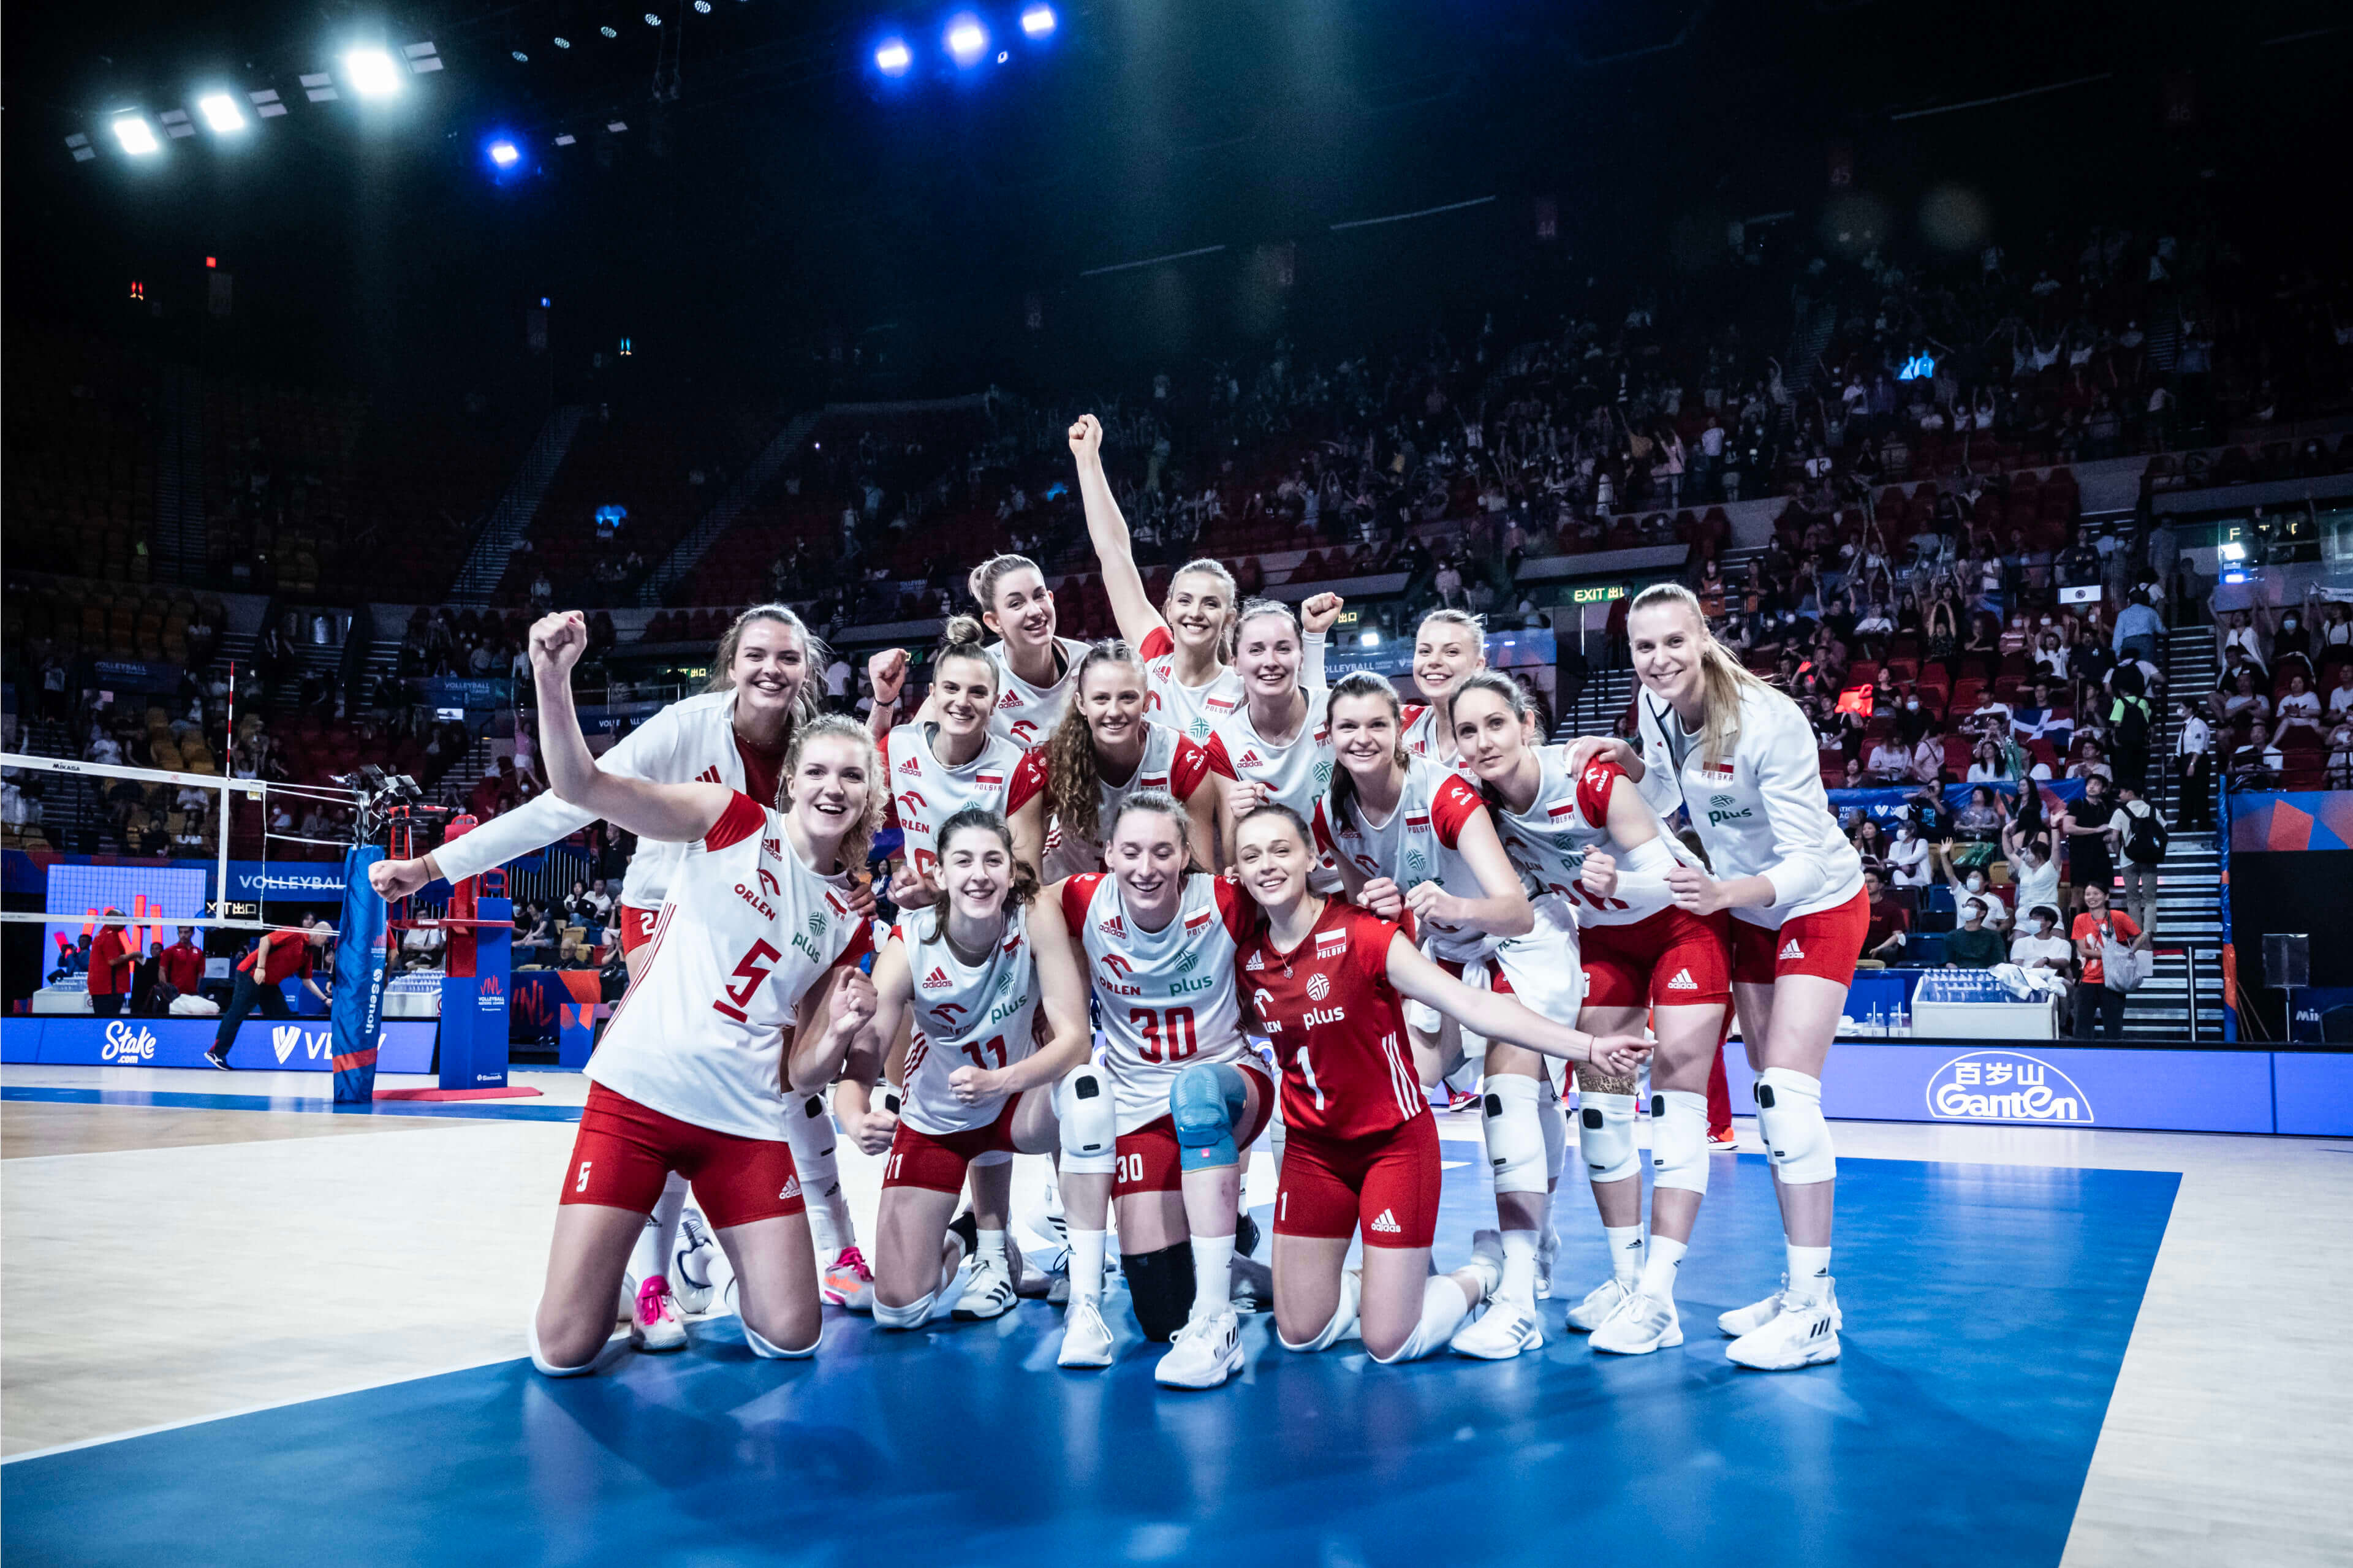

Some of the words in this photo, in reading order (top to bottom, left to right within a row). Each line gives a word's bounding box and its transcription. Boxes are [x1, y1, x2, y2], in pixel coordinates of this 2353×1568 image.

[1574, 588, 1605, 602] EXIT
[1338, 612, 1357, 623] 出口
[691, 668, 707, 678] 出口
[1324, 662, 1374, 673] OLLEYBALL
[998, 700, 1024, 709] adidas
[898, 766, 922, 777] adidas
[1596, 770, 1609, 792] ORLEN
[901, 818, 930, 834] RLEN
[1708, 808, 1752, 827] plus
[1408, 876, 1445, 888] pls
[233, 903, 256, 915] 出口
[734, 883, 776, 922] ORLEN
[1099, 924, 1127, 939] adidas
[792, 931, 821, 964] plus
[1317, 944, 1347, 960] POLSKA
[726, 937, 782, 1008] 5
[1246, 963, 1265, 971] adidas
[922, 980, 953, 989] adidas
[1099, 976, 1141, 996] ORLEN
[1170, 975, 1213, 996] plus
[991, 995, 1028, 1025] plus
[1303, 1006, 1346, 1031] plus
[1130, 1006, 1197, 1064] 30
[1262, 1020, 1283, 1033] LEN
[101, 1020, 157, 1060] Stake
[117, 1055, 138, 1064] .com
[1297, 1046, 1324, 1110] 1
[1955, 1062, 2044, 1086] 百岁山
[1936, 1083, 2078, 1119] Ganten
[887, 1153, 903, 1180] 11
[1116, 1153, 1143, 1184] 30
[576, 1162, 592, 1192] 5
[1371, 1222, 1401, 1233] adidas
